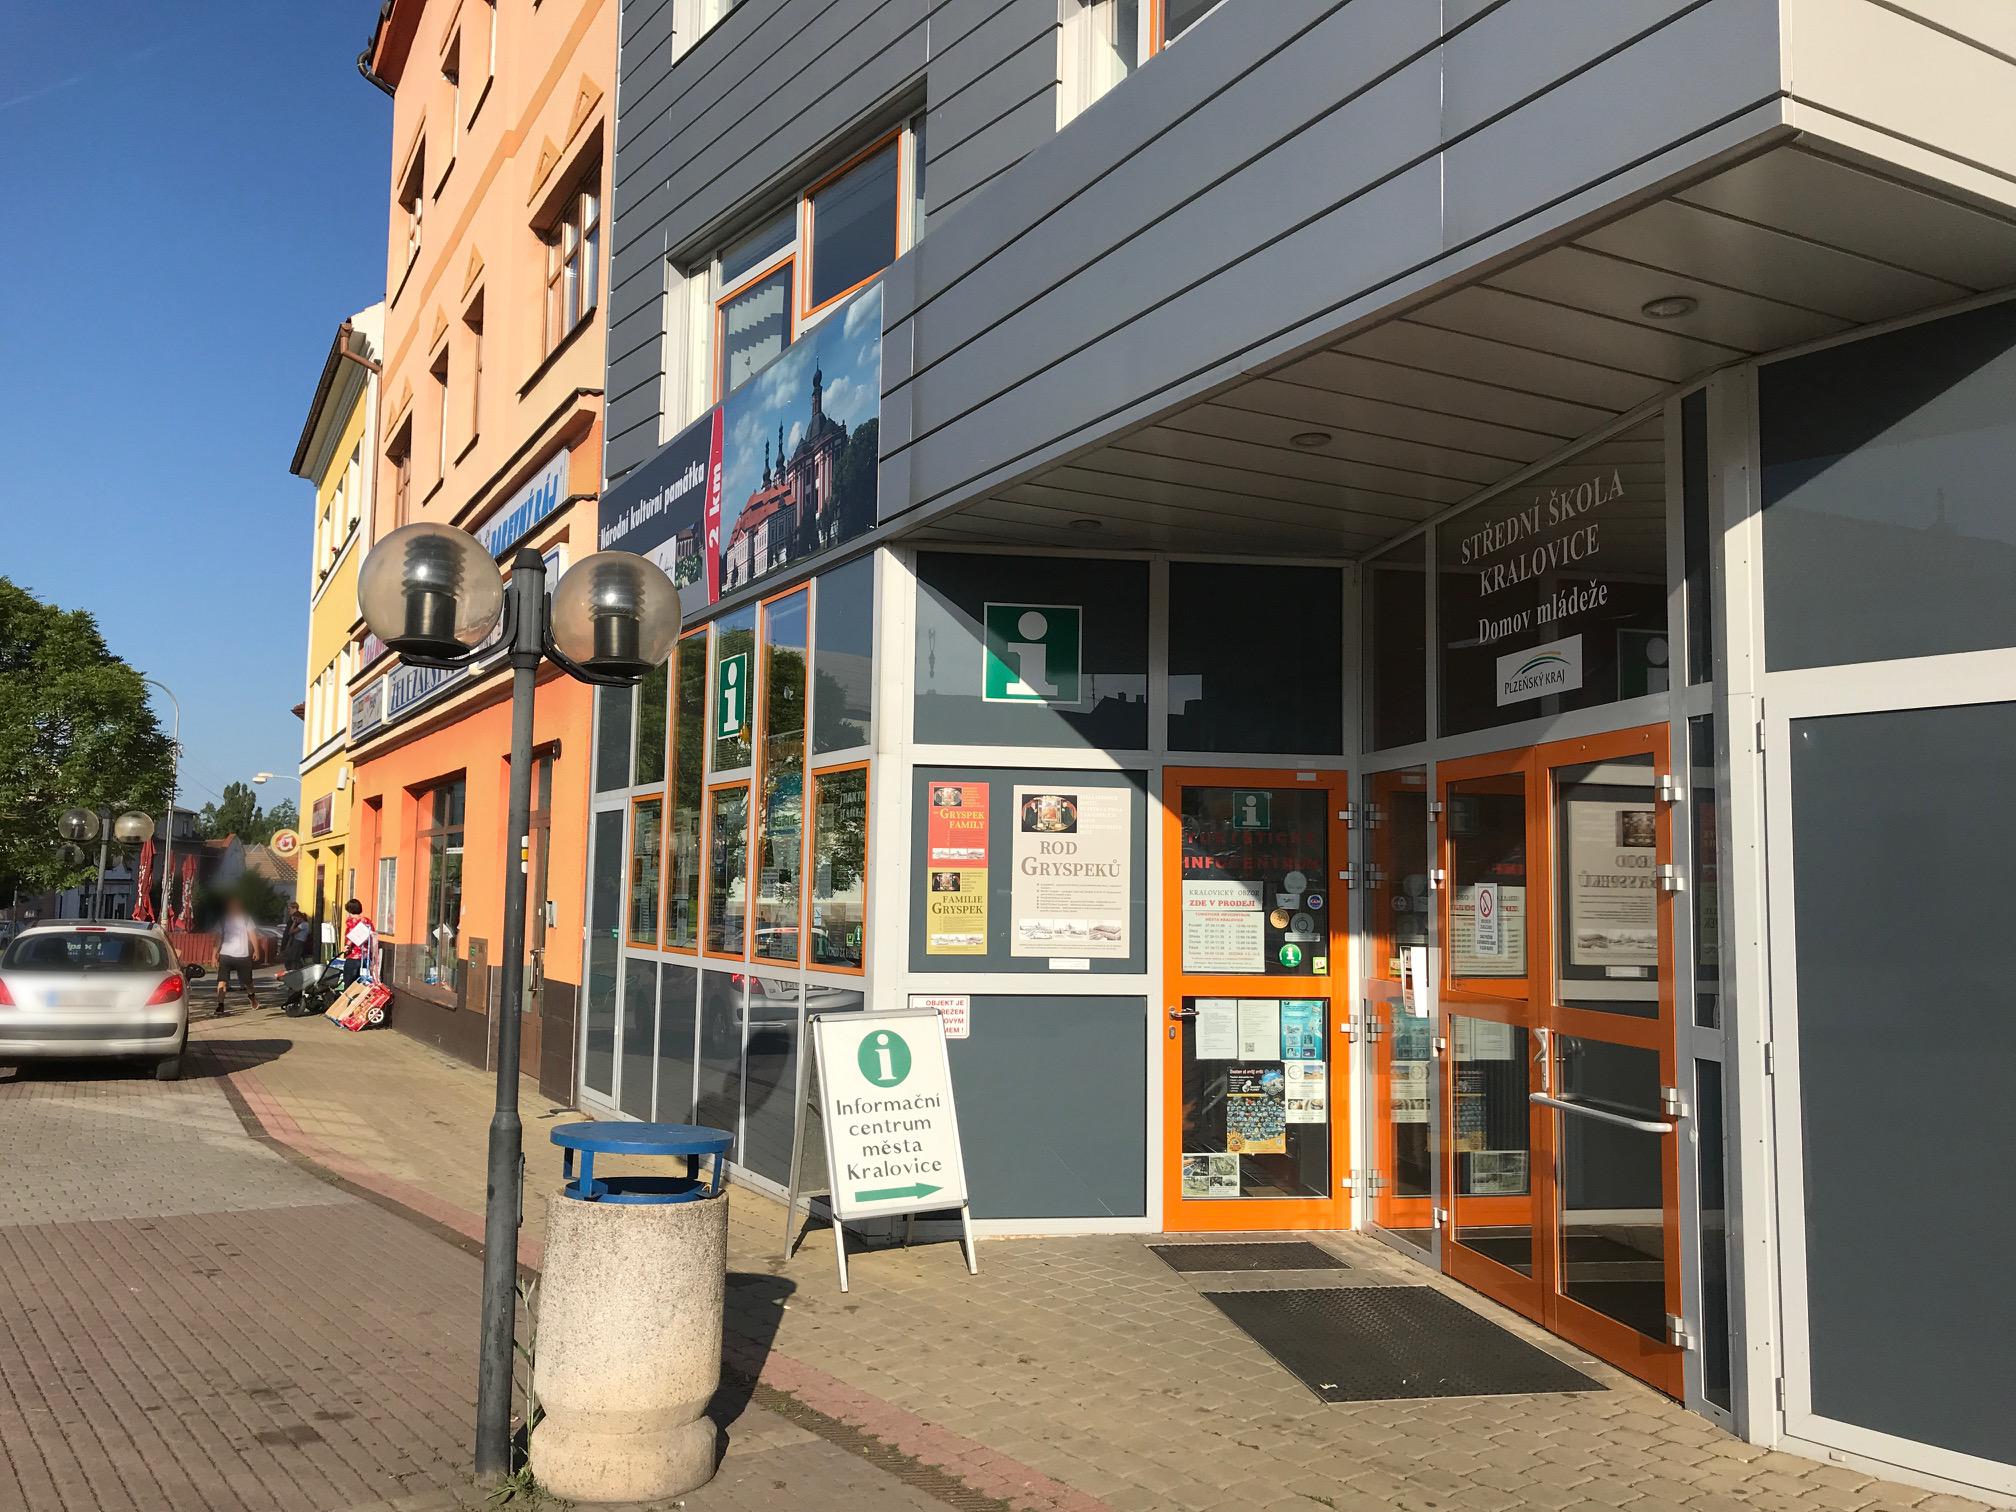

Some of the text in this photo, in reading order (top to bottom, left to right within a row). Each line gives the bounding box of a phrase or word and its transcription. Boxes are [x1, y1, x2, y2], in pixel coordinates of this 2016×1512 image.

[600, 461, 705, 550] Národní kulturní památka
[709, 462, 721, 549] 2 km
[1461, 468, 1625, 565] STŘEDNÍ ŠKOLA
[1479, 523, 1600, 597] KRALOVICE
[1477, 578, 1609, 645] Domov mládeže
[1503, 668, 1566, 696] PLZEŇSKÝ KRAJ
[939, 808, 985, 819] GRYSPEK
[949, 820, 984, 829] FAMILY
[1039, 840, 1078, 855] ROD
[1021, 856, 1121, 877] GRYSPEKŮ
[931, 902, 983, 915] GRYSPEK
[942, 895, 983, 904] FAMILIE
[1189, 899, 1208, 907] ZDE
[1209, 899, 1216, 907] V
[836, 1093, 941, 1116] Informační
[849, 1118, 932, 1137] centrum
[862, 1138, 923, 1157] města
[847, 1157, 943, 1181] Kralovice
